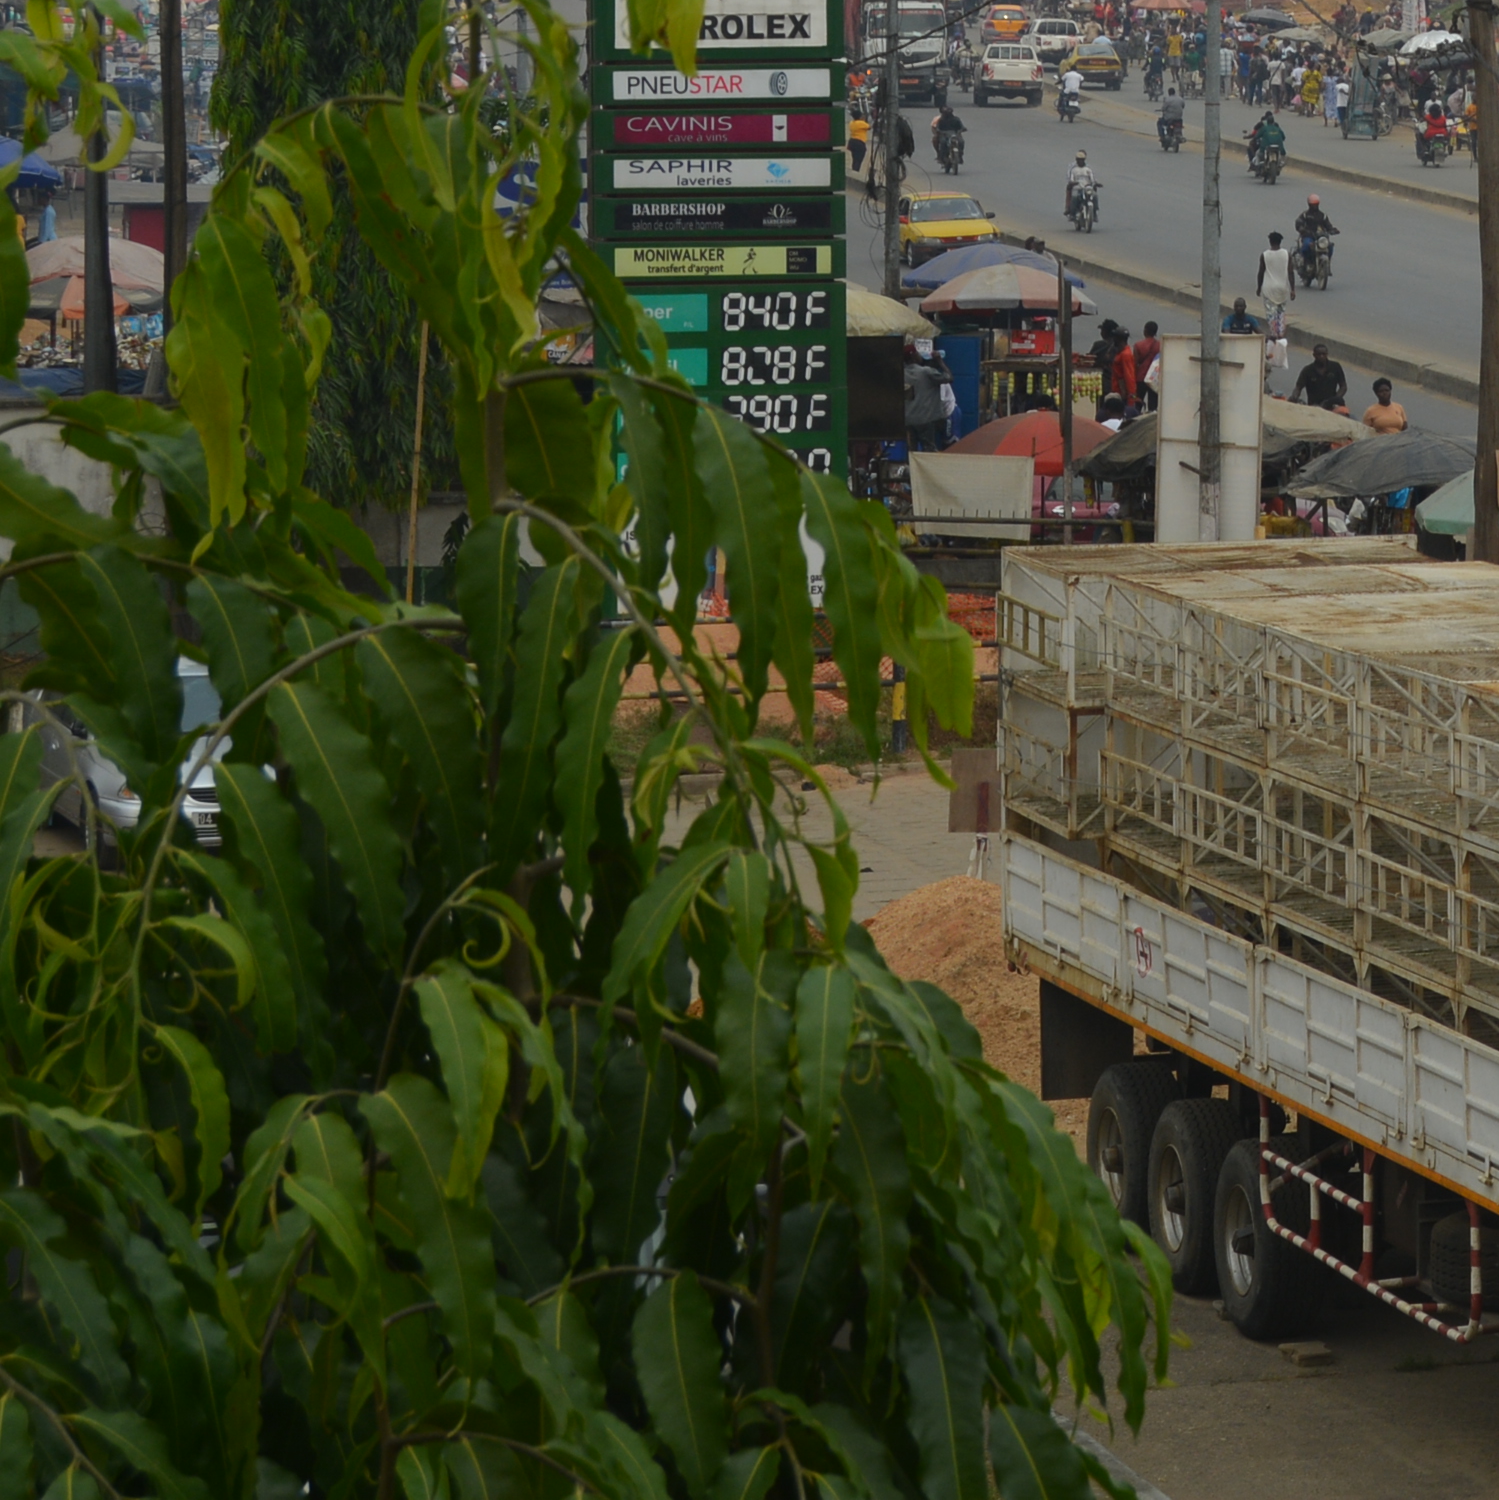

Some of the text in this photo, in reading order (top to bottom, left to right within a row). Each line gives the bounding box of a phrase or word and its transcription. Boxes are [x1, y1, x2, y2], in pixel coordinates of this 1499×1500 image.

[627, 75, 743, 94] PNEUSTAR
[627, 116, 733, 132] CAVINIS
[668, 132, 694, 142] cave
[708, 131, 728, 142] vins
[629, 160, 733, 173] SAPHIR
[677, 174, 732, 186] laveries
[632, 203, 726, 216] BARBERSHOP
[632, 218, 724, 231] salon de coiffure homme
[633, 248, 725, 263] MONIWALKER
[647, 263, 724, 275] transfert d'argent
[722, 291, 827, 331] 840 F
[805, 345, 827, 381] F
[805, 394, 828, 430] F
